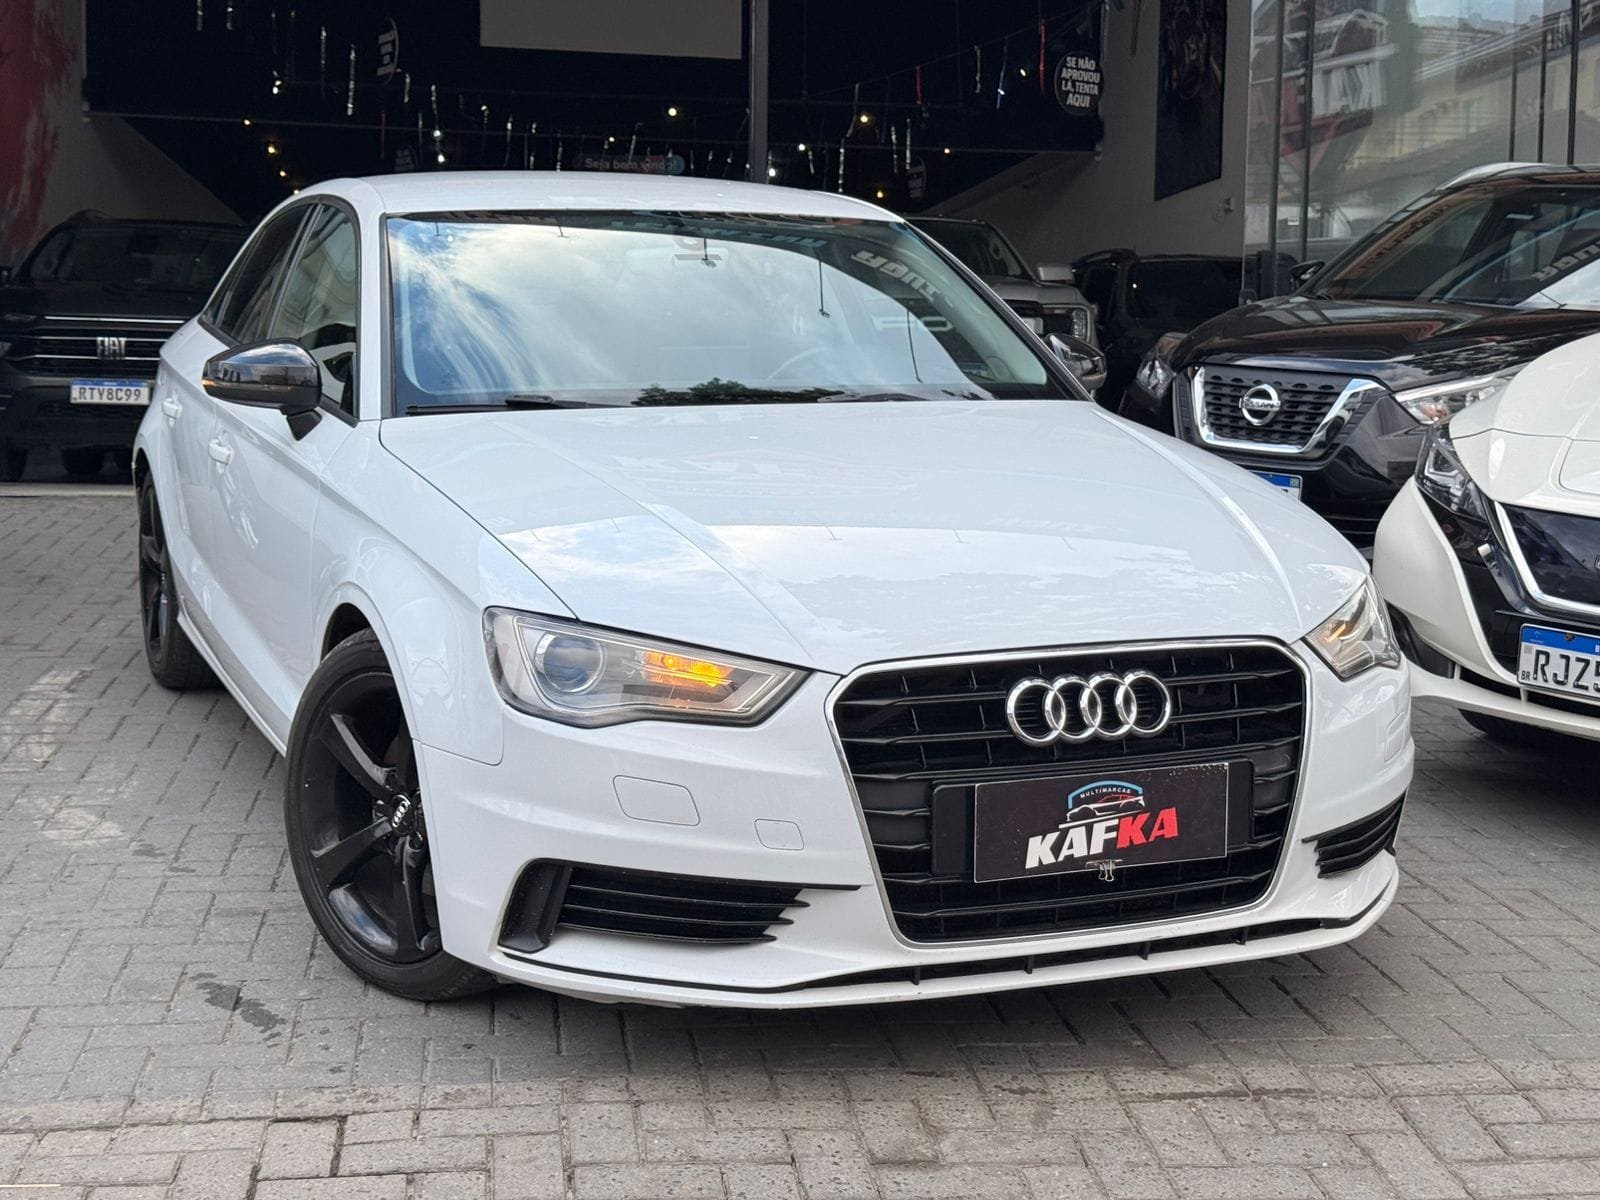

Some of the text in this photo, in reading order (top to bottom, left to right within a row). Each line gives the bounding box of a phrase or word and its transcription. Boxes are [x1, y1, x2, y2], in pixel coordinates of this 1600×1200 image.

[1066, 56, 1096, 70] SE NÃO
[1061, 67, 1100, 83] APROVOU
[1075, 82, 1098, 95] TENTA
[1066, 92, 1091, 108] AQUI
[96, 336, 127, 360] FIAT
[78, 387, 142, 401] RTY8C99
[1025, 807, 1179, 869] KAFKA
